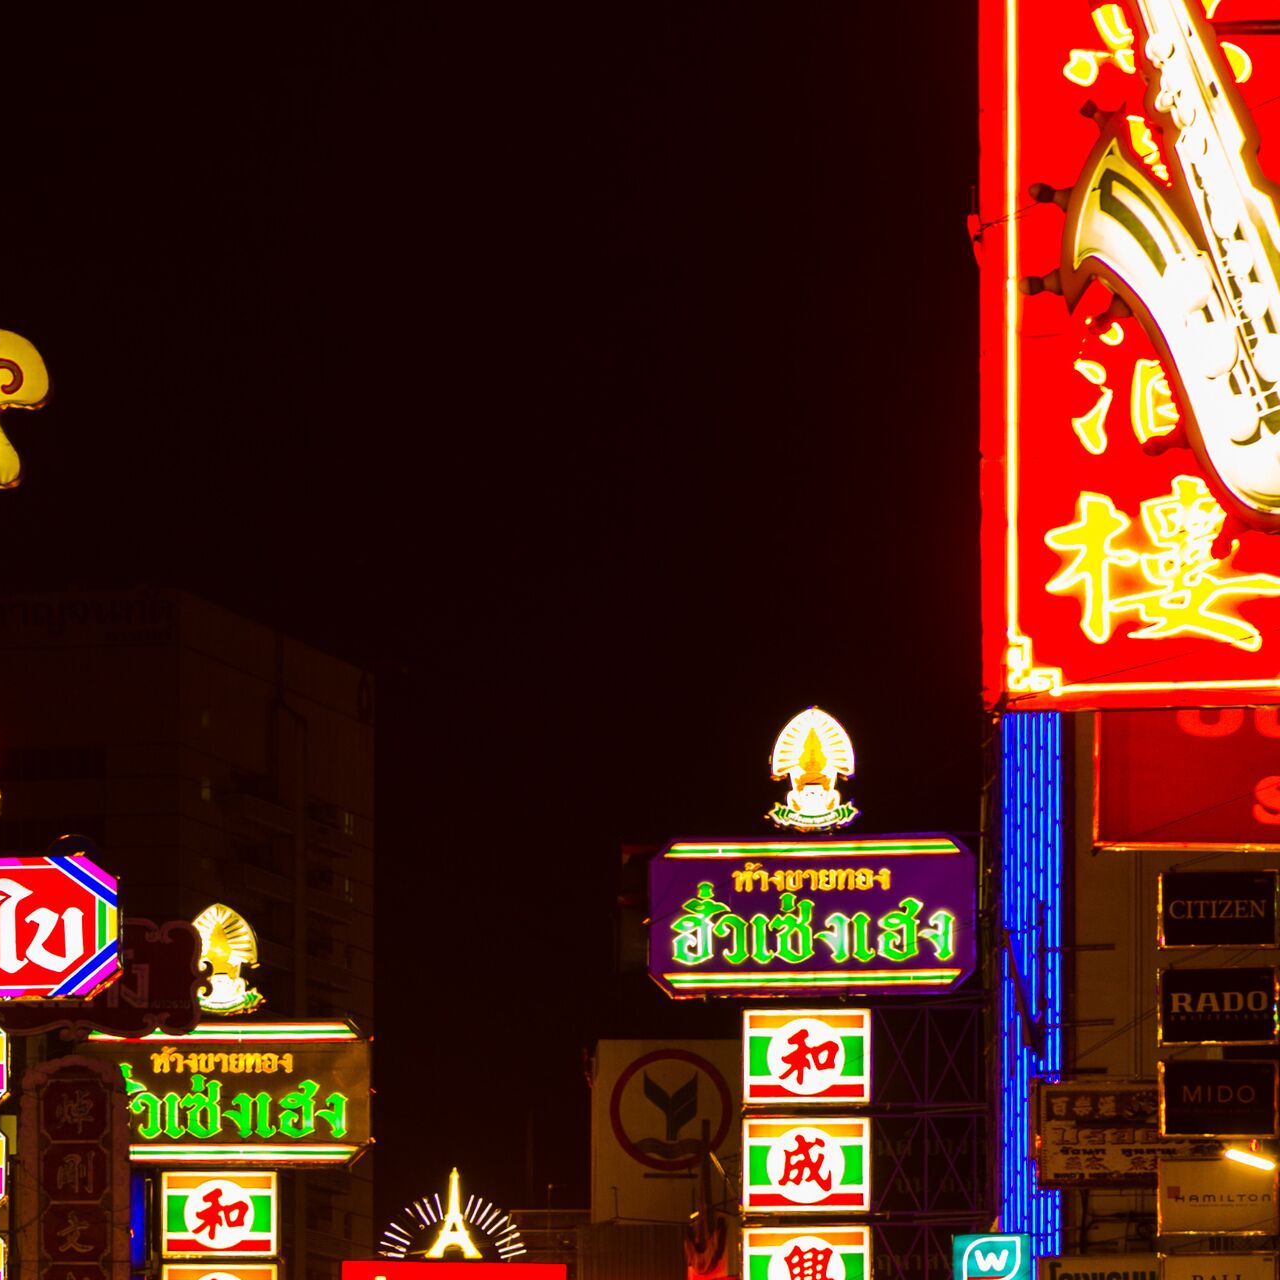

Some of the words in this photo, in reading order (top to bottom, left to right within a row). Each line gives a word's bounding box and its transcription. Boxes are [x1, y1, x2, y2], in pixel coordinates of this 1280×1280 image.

[731, 862, 892, 894] ห้างขายทอง
[1168, 899, 1267, 920] CITIZEN
[671, 881, 957, 966] ฮั่วเซ่งเฮง
[1169, 991, 1268, 1014] RADO
[150, 1047, 293, 1074] ห้างขายทอง
[124, 1062, 349, 1140] ั่วเซ่งเฮง
[1181, 1085, 1256, 1104] MIDO
[1175, 1192, 1273, 1203] HAMILTON
